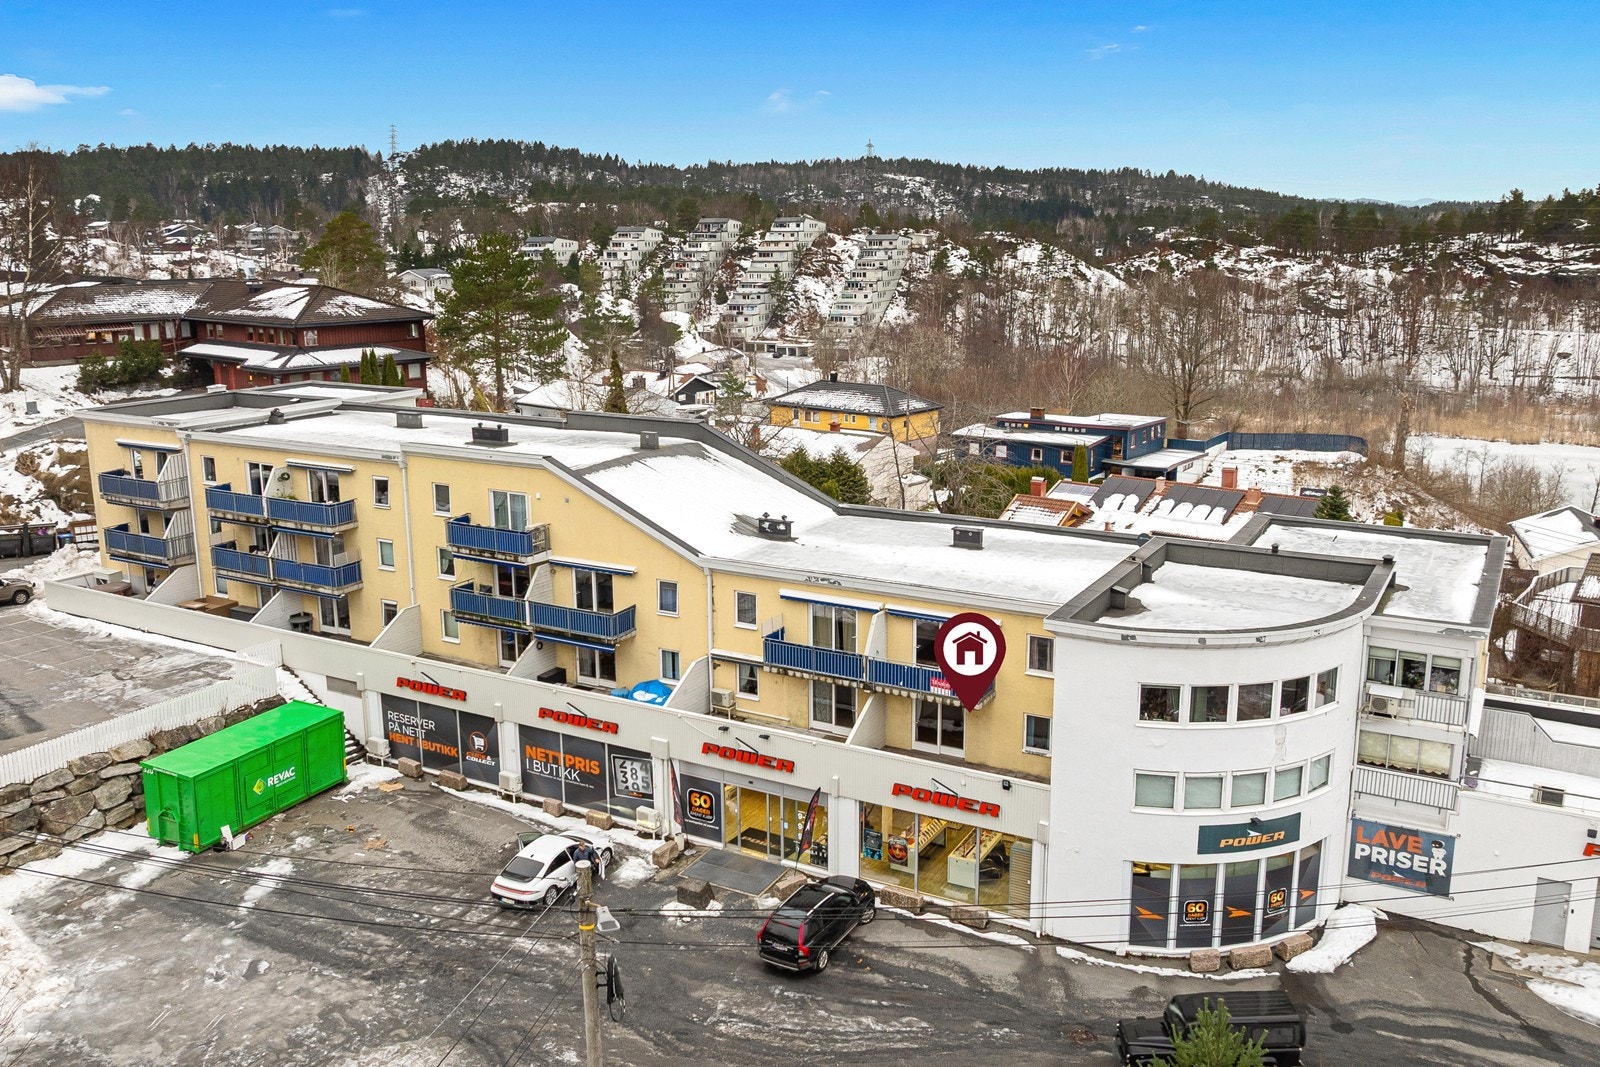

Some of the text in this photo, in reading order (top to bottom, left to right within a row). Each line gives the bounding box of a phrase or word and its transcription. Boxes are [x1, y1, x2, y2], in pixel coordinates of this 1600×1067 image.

[396, 676, 467, 702] POWER
[387, 710, 436, 731] RESERVER
[388, 721, 426, 739] PÅ NETT
[538, 707, 619, 735] POWER
[388, 731, 415, 747] HENT
[422, 740, 459, 758] BUTIKK
[525, 744, 600, 775] NETTPRIS
[701, 742, 795, 773] POWER
[267, 766, 296, 787] REVAC
[533, 759, 581, 782] BUTIKK
[690, 792, 711, 809] 60
[891, 782, 1001, 818] POWER
[1219, 831, 1286, 848] POWER
[1356, 825, 1423, 855] LAVE
[1354, 842, 1447, 878] PRISER
[1186, 902, 1206, 913] 60
[1270, 890, 1285, 904] 60
